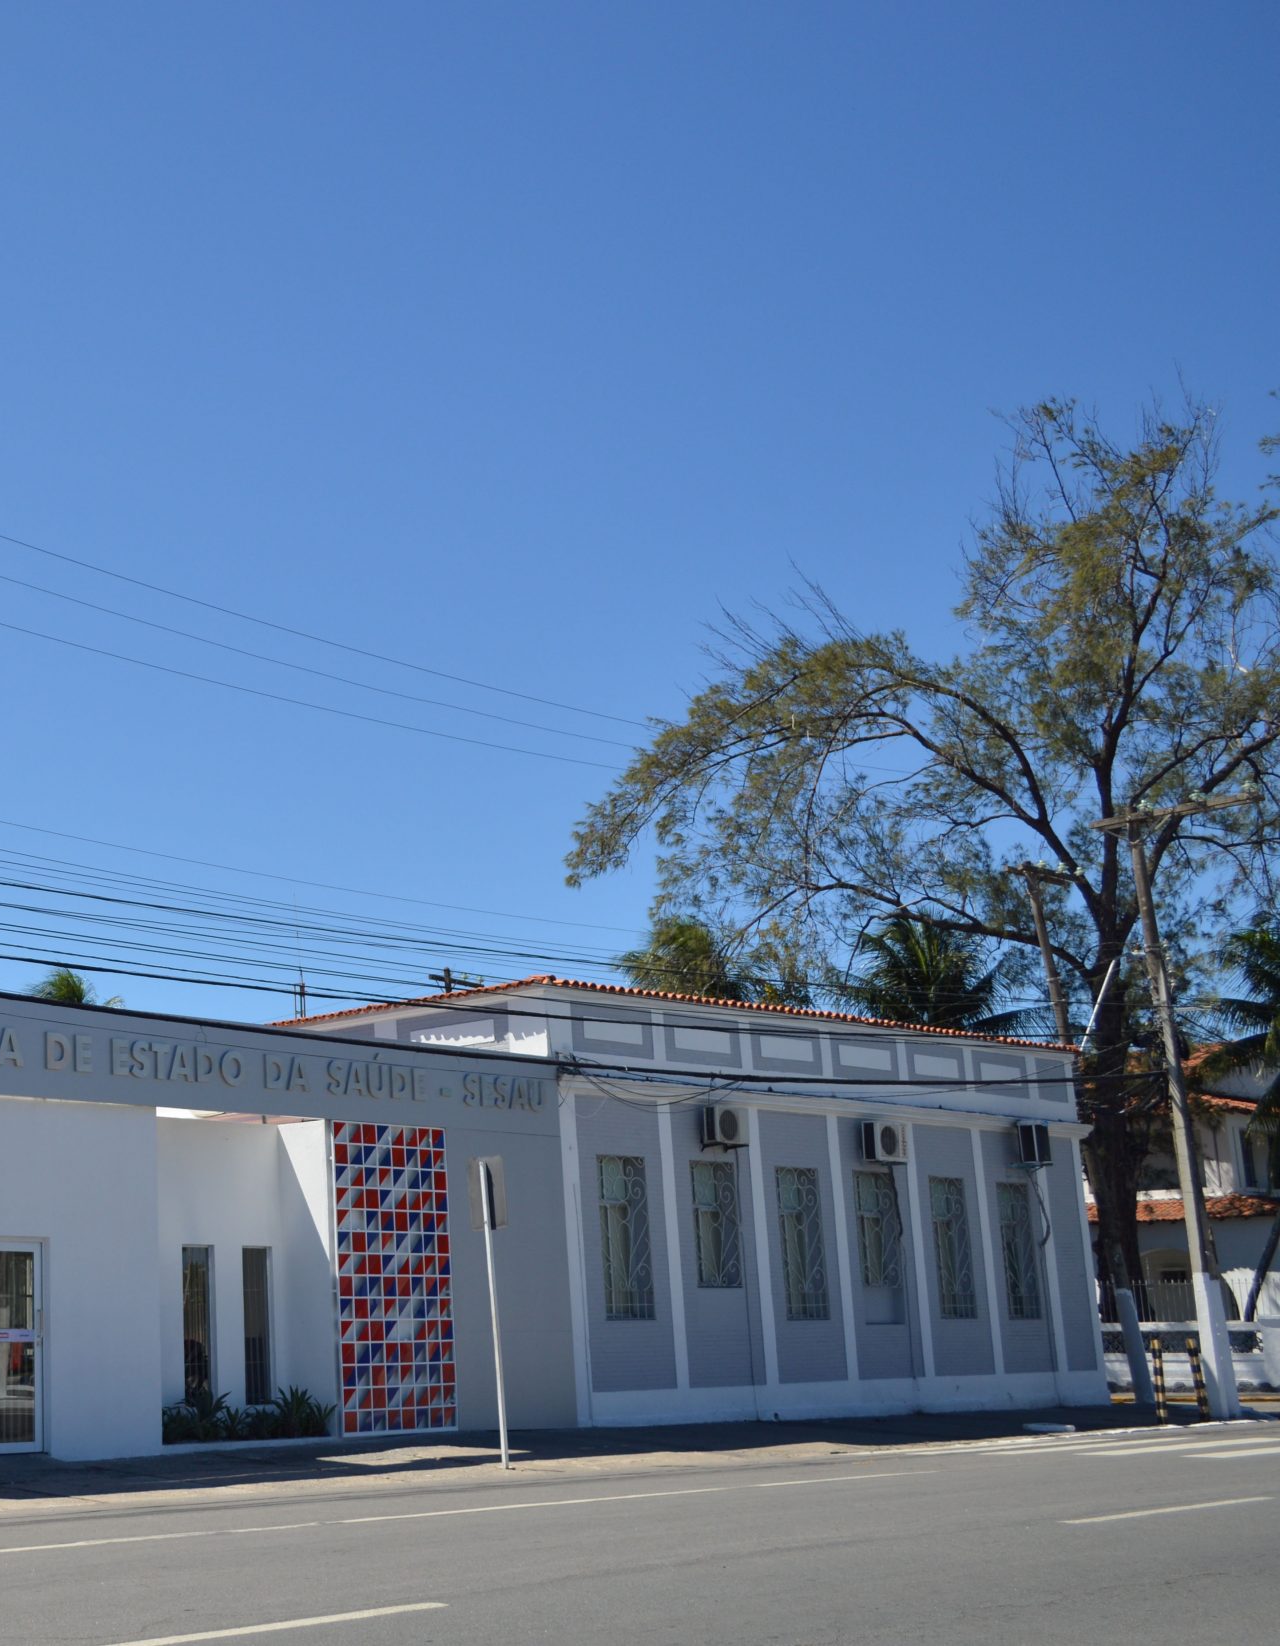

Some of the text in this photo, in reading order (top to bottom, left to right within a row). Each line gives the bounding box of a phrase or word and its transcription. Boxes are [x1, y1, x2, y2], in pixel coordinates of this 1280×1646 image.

[43, 1030, 94, 1073] DE
[111, 1037, 242, 1087] ESTADO
[263, 1053, 311, 1094] DA
[326, 1052, 425, 1102] SAÚDE
[461, 1072, 545, 1113] SESAU
